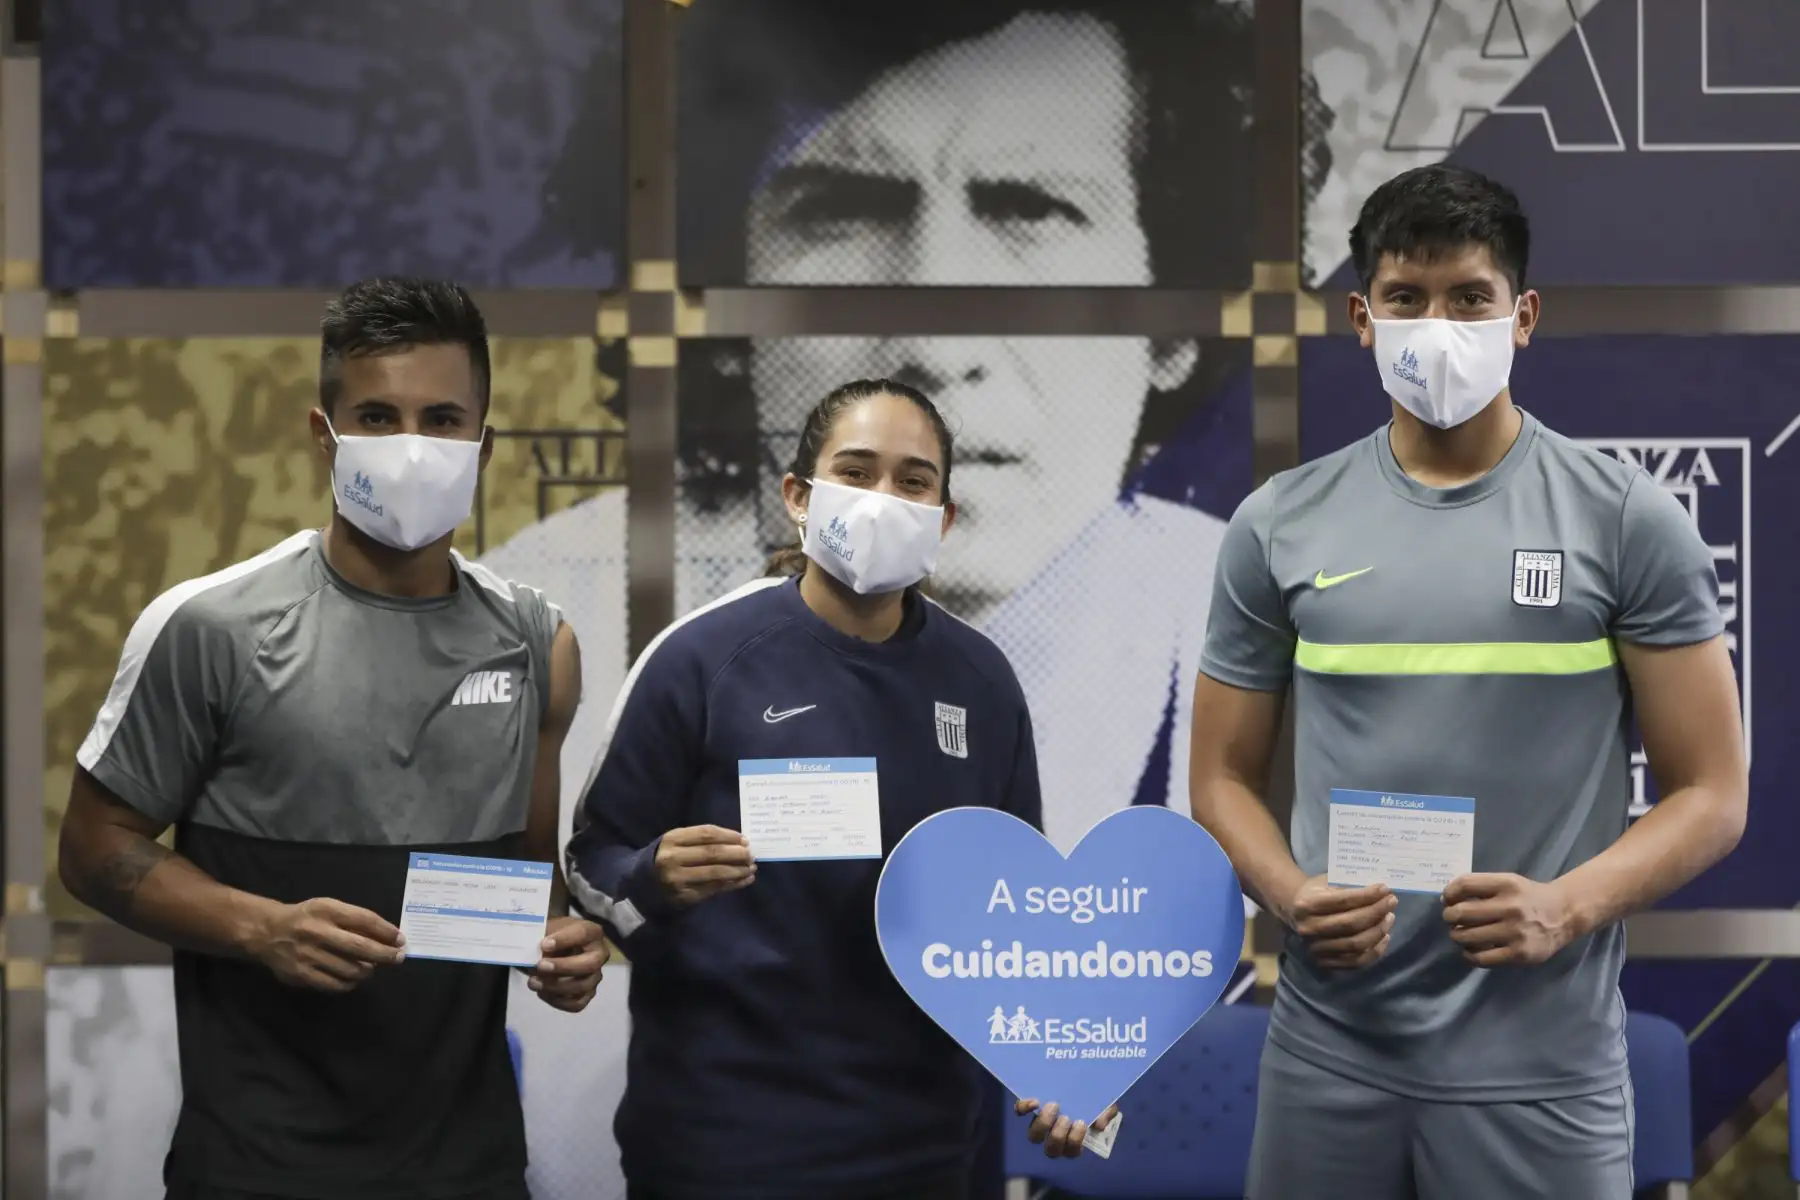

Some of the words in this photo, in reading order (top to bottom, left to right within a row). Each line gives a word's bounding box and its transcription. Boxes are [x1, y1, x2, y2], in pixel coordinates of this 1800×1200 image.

[1392, 362, 1427, 389] EsSalud
[344, 484, 383, 517] EsSalud
[819, 528, 854, 562] EsSalud
[1521, 553, 1556, 561] ALIANZA
[451, 671, 512, 706] NIKE
[1395, 799, 1425, 809] EsSalud
[987, 880, 1015, 912] A
[1026, 878, 1147, 923] seguir
[922, 940, 1212, 978] Cuidandonos
[1045, 1017, 1146, 1043] EsSalud
[1047, 1047, 1077, 1058] Perú
[1081, 1046, 1146, 1058] saludable
